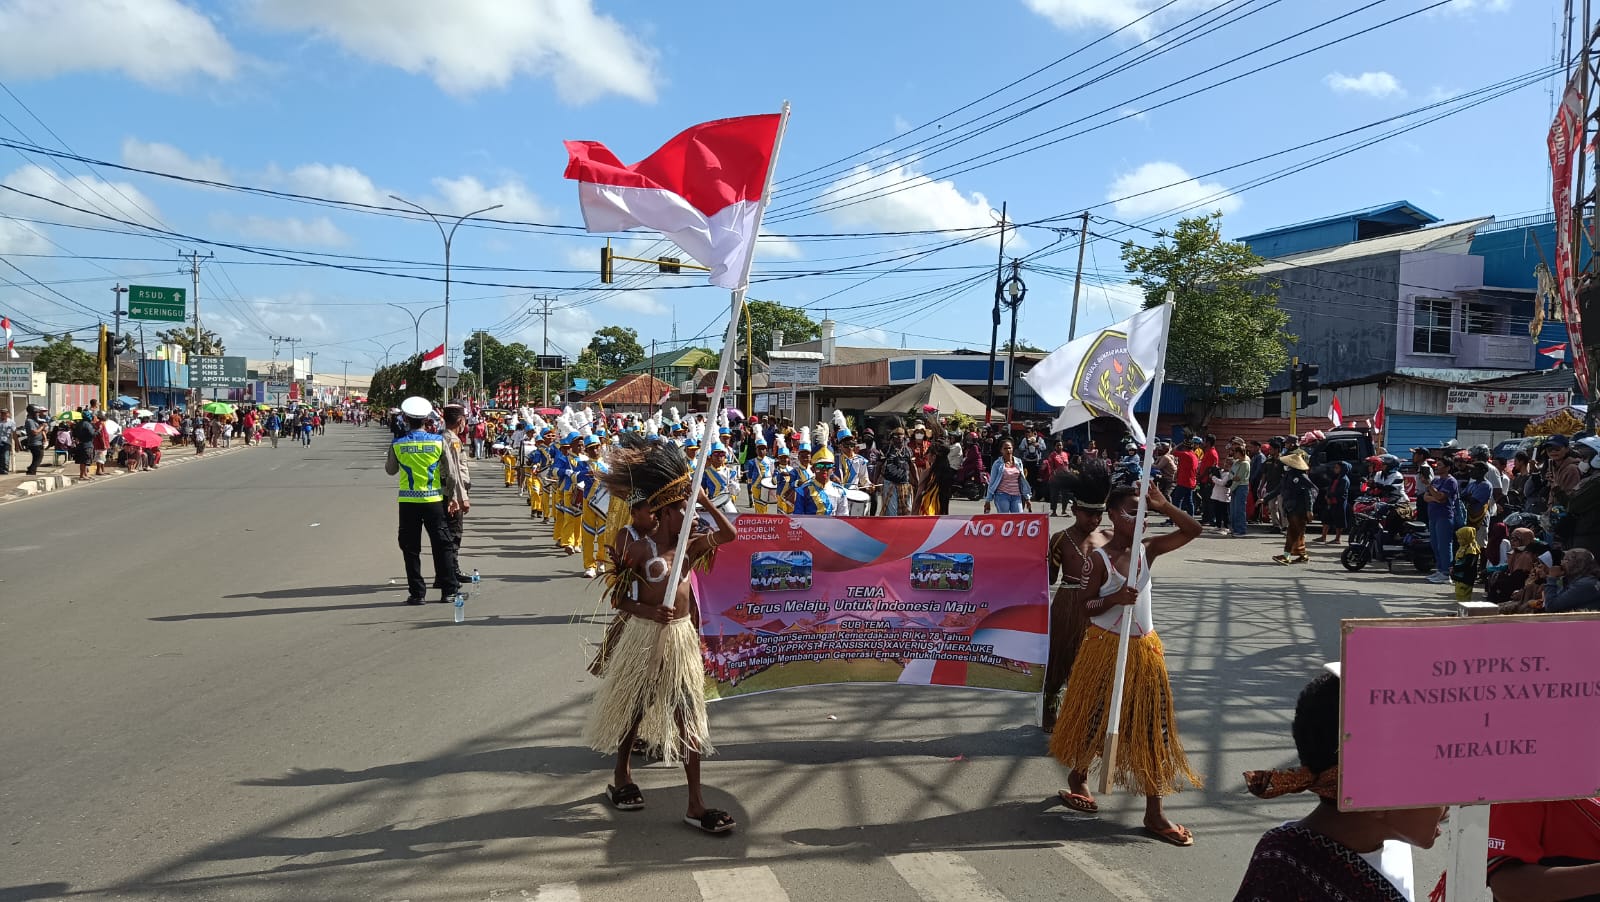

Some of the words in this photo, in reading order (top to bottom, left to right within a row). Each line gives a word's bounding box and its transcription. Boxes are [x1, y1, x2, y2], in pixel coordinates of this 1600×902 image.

[143, 308, 183, 317] SERINGGU
[400, 446, 436, 454] POLISI
[964, 520, 994, 536] No
[1001, 520, 1041, 537] 016
[737, 533, 780, 541] INDONESIA
[846, 586, 885, 598] TEMA
[747, 603, 781, 614] Terus
[835, 600, 873, 610] Untuk
[877, 600, 941, 612] Indonesia
[945, 601, 977, 614] Maju
[841, 621, 861, 629] SUB
[864, 621, 891, 629] TEMA
[756, 634, 789, 645] Dengan
[791, 632, 836, 641] Semangat
[914, 632, 927, 640] Ke
[929, 632, 940, 640] 78
[943, 633, 970, 641] Tahun
[765, 645, 778, 654] SD
[780, 643, 804, 652] YPPK
[823, 641, 884, 649] FRANSISKUS
[885, 641, 934, 650] XAVERIUS
[943, 644, 994, 654] MERAUKE
[727, 660, 747, 669] Terus
[749, 656, 775, 667] Melaju
[777, 652, 830, 663] Membangun
[833, 651, 873, 660] Generasi
[875, 651, 900, 659] Emas
[903, 650, 931, 659] Untuk
[932, 651, 977, 662] Indonesia
[979, 655, 1002, 665] Maju
[1431, 660, 1457, 677] SD
[1462, 656, 1515, 675] YPPK
[1519, 655, 1550, 673] ST.
[1368, 684, 1497, 706] FRANSISKUS
[1502, 680, 1600, 701] XAVERIUS
[1434, 739, 1537, 760] MERAUKE
